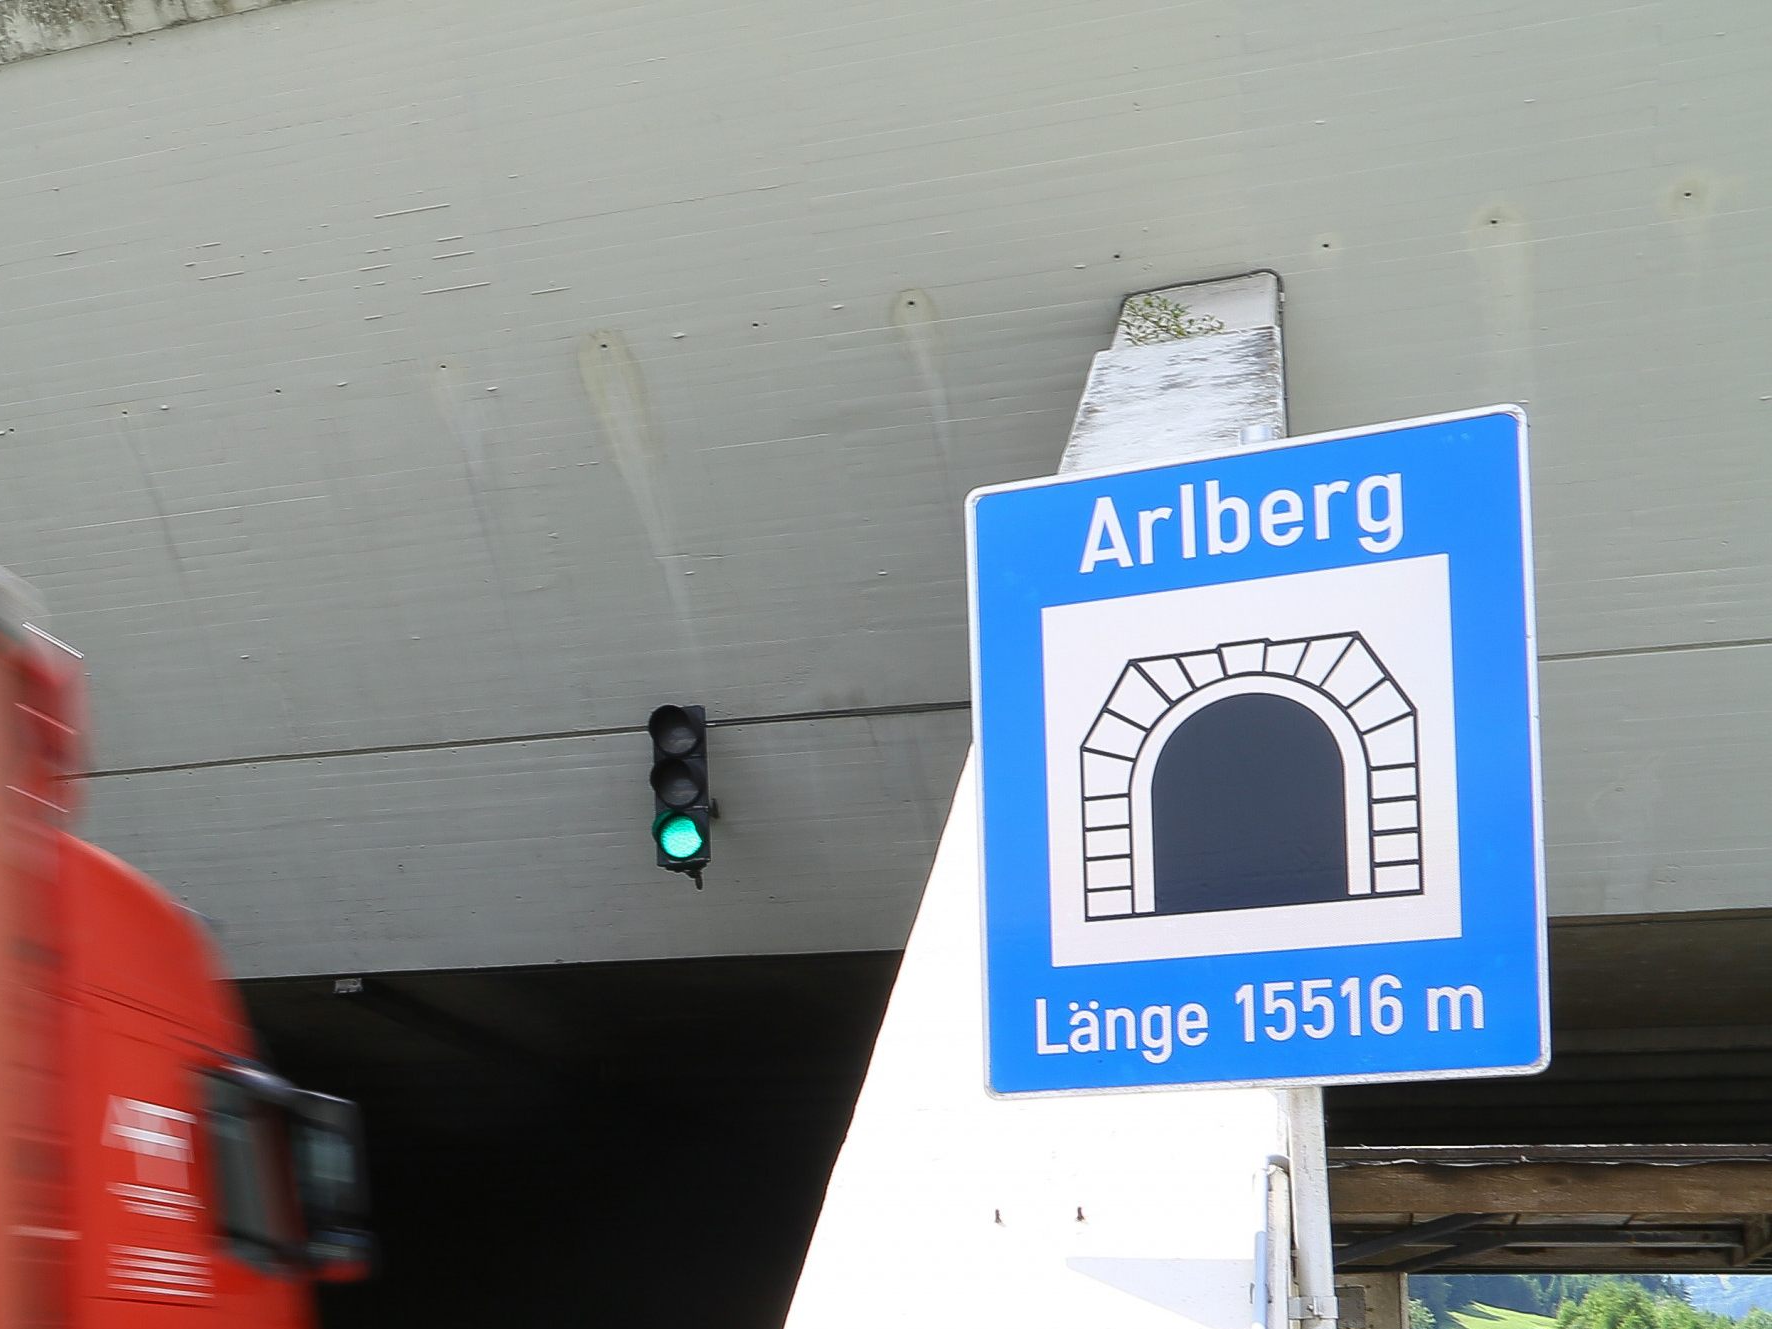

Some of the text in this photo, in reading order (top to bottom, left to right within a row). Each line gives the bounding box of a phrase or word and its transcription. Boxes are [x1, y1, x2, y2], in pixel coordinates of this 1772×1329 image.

[1079, 472, 1404, 574] Arlberg
[1035, 974, 1485, 1064] Länge 15516 m
